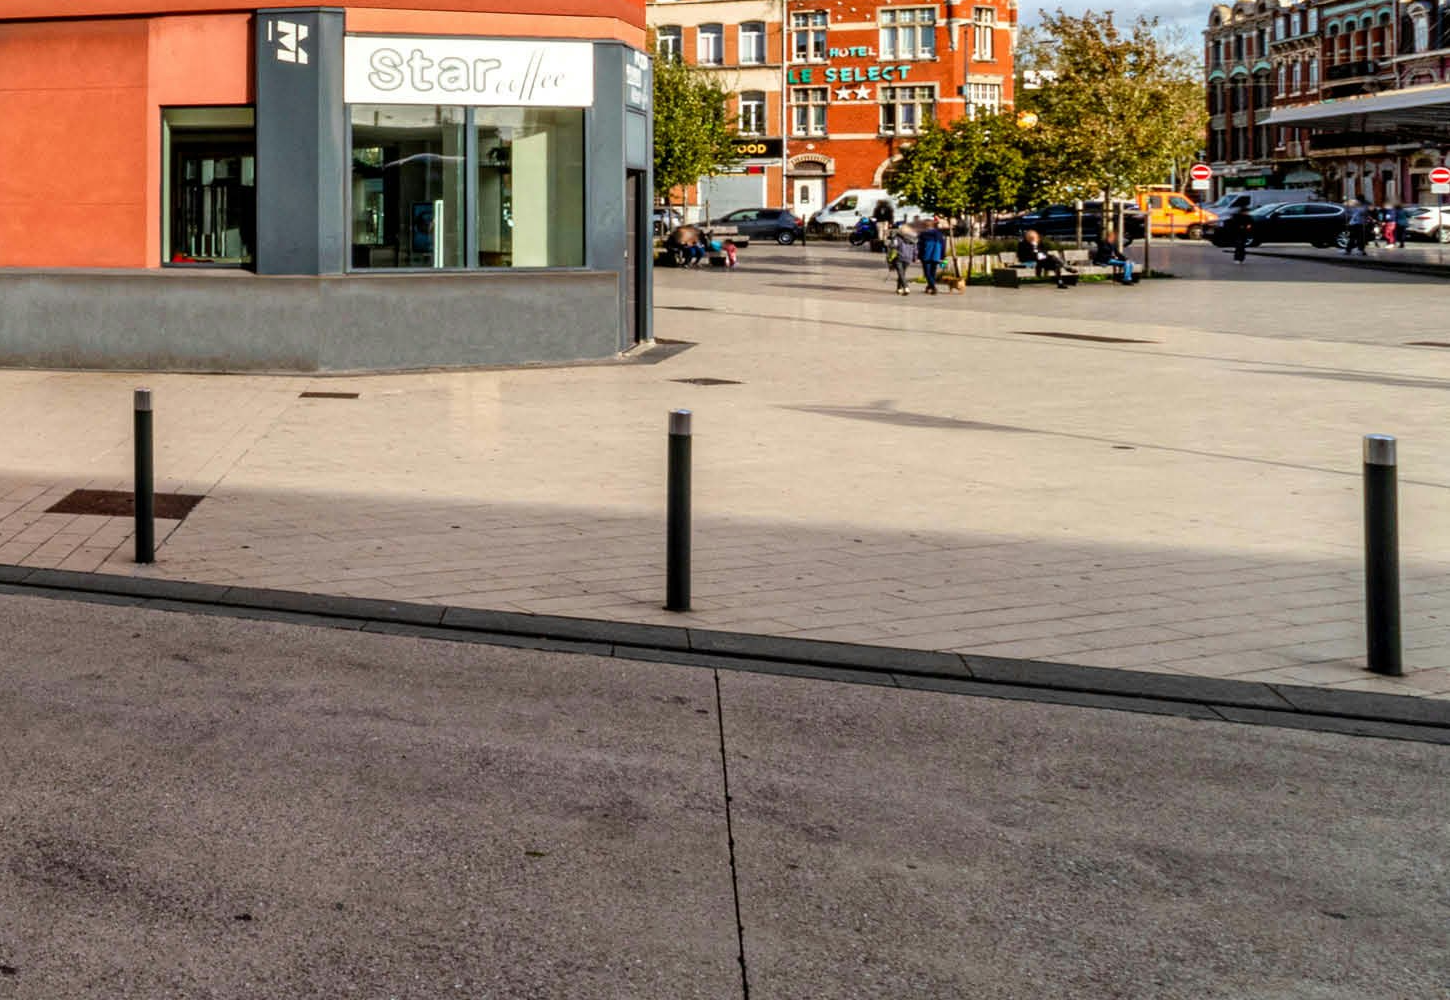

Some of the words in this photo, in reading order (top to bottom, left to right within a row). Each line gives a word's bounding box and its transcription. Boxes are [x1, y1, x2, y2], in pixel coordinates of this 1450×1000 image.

[829, 47, 877, 58] HOTEL
[368, 48, 502, 93] Star
[787, 68, 813, 84] LE
[825, 65, 912, 83] SELECT
[731, 144, 767, 154] OOD
